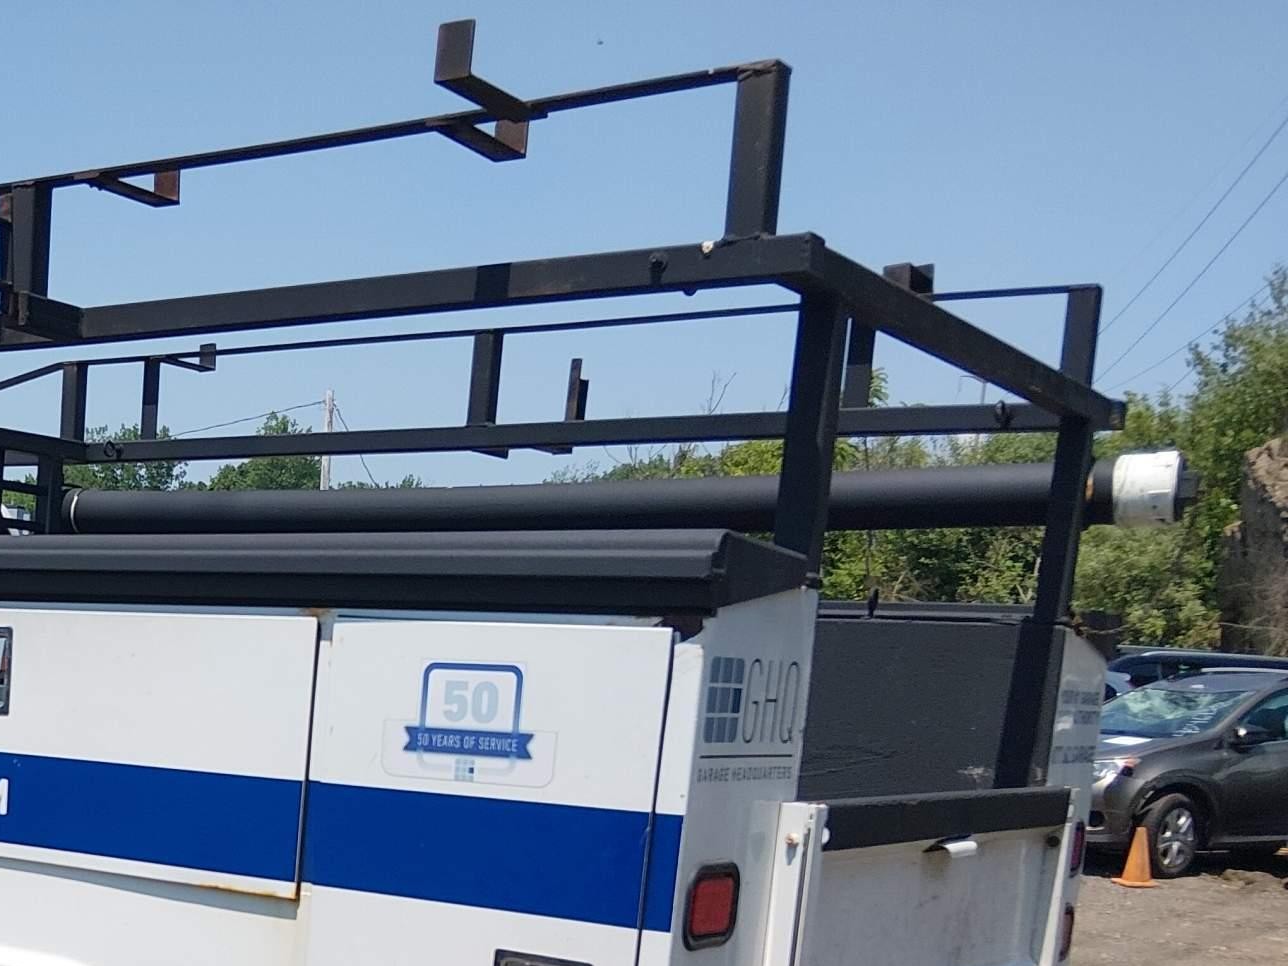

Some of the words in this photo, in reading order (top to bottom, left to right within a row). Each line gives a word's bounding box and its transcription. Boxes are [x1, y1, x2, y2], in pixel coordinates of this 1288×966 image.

[443, 680, 499, 723] 50
[742, 658, 801, 744] GHQ
[417, 733, 430, 746] 50
[432, 734, 461, 749] YEARS
[463, 736, 476, 749] OF
[478, 737, 518, 752] SERVICE
